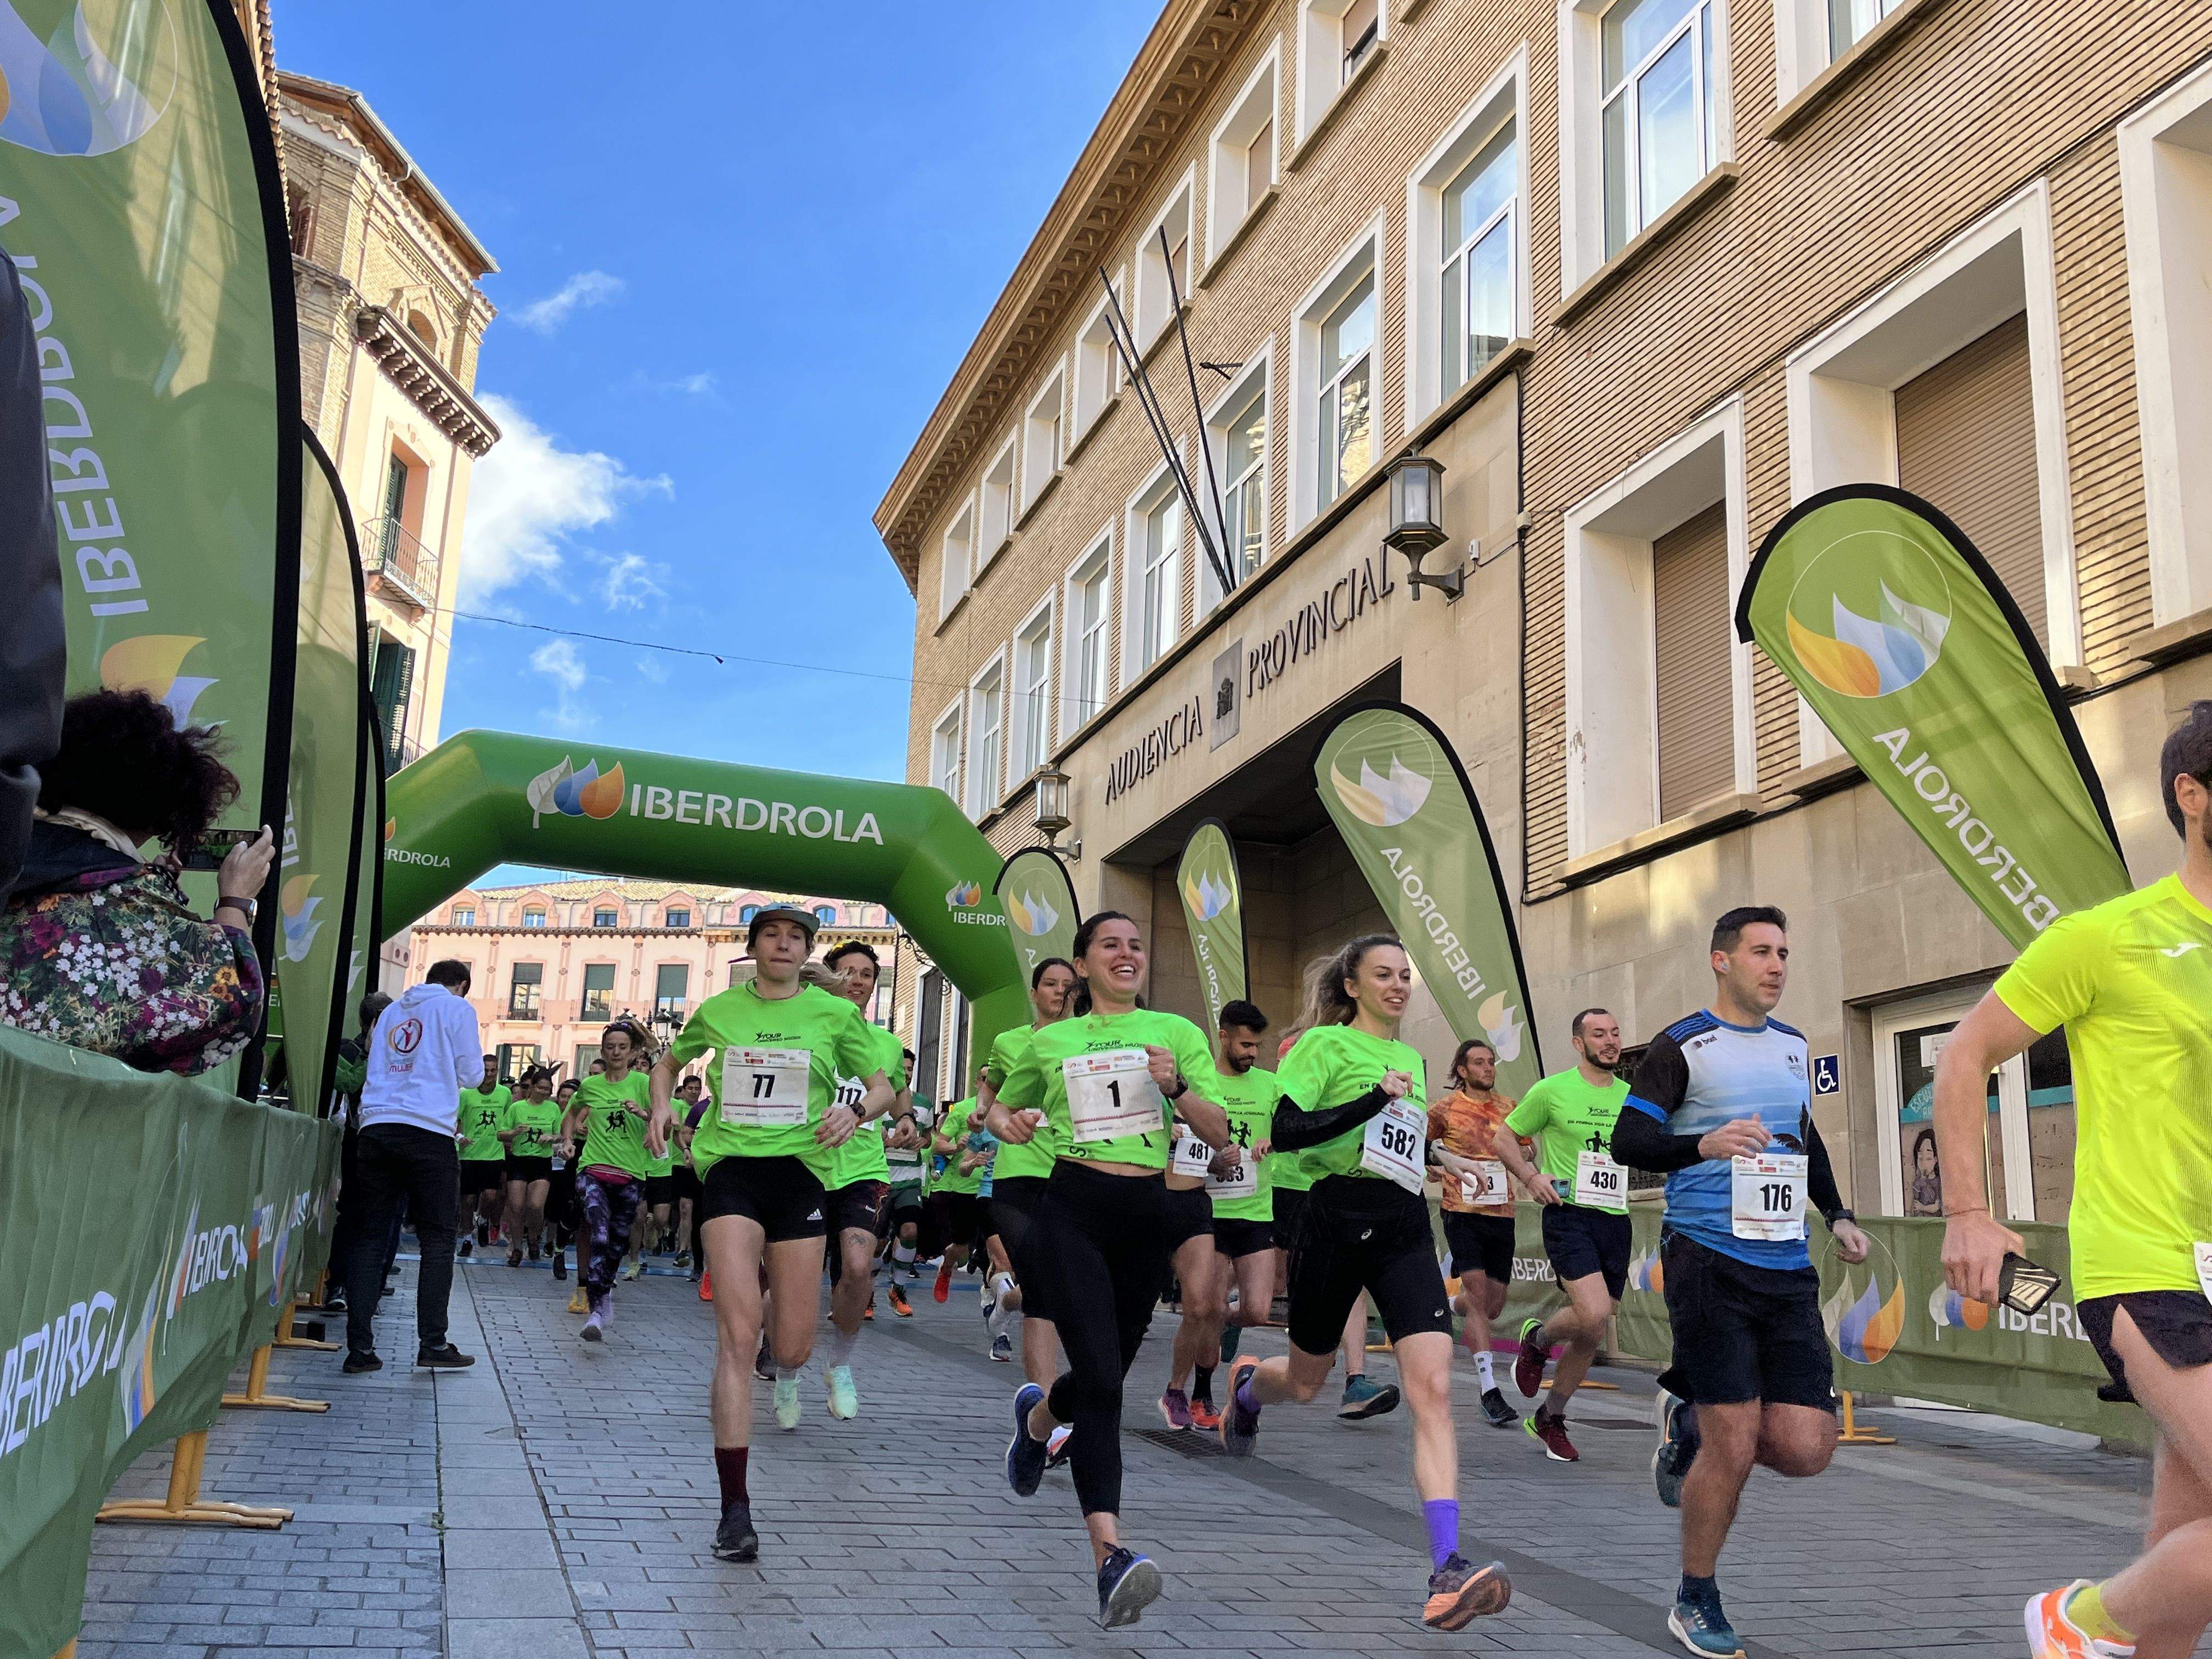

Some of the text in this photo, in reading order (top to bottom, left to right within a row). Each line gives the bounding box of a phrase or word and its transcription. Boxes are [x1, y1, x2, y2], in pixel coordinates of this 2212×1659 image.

[1105, 544, 1395, 805] AUDIENCIA PROVINCIAL
[630, 783, 884, 845] IBERDROLA
[953, 912, 1007, 927] IBERDR
[752, 1074, 775, 1098] 77
[837, 1086, 862, 1105] 117
[1107, 1080, 1121, 1107] 1
[1188, 1143, 1209, 1160] 481
[1381, 1122, 1416, 1161] 582
[1590, 1171, 1617, 1190] 430
[1759, 1184, 1792, 1212] 176
